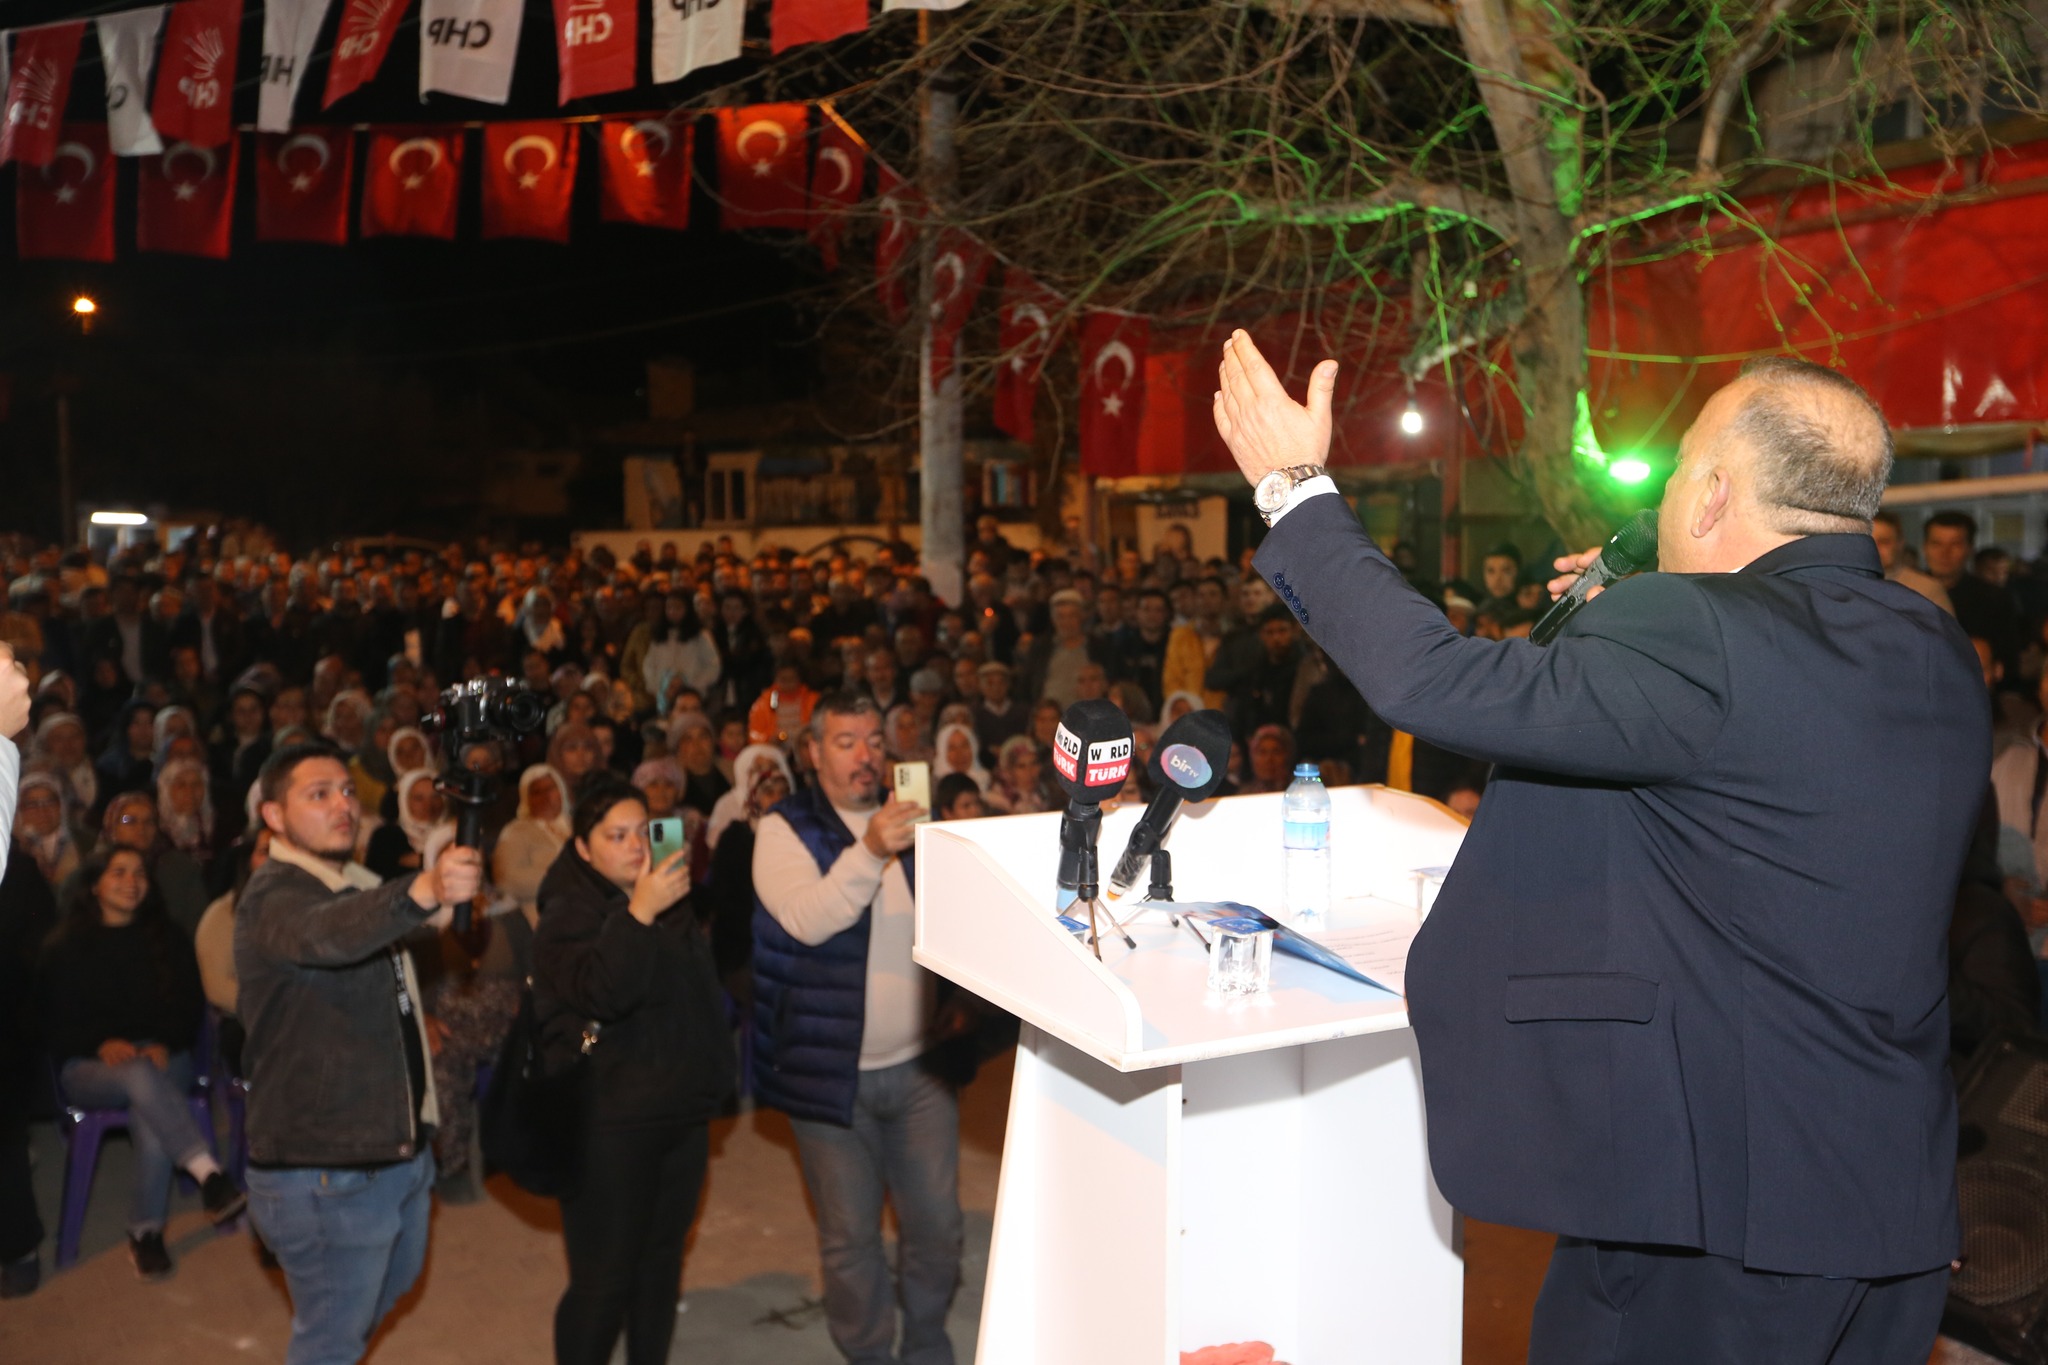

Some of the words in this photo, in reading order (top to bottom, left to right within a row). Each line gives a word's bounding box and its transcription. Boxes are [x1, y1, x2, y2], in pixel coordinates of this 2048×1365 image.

[1090, 744, 1129, 761] WRLD
[1089, 763, 1128, 782] TÜRK
[1170, 754, 1192, 773] bir
